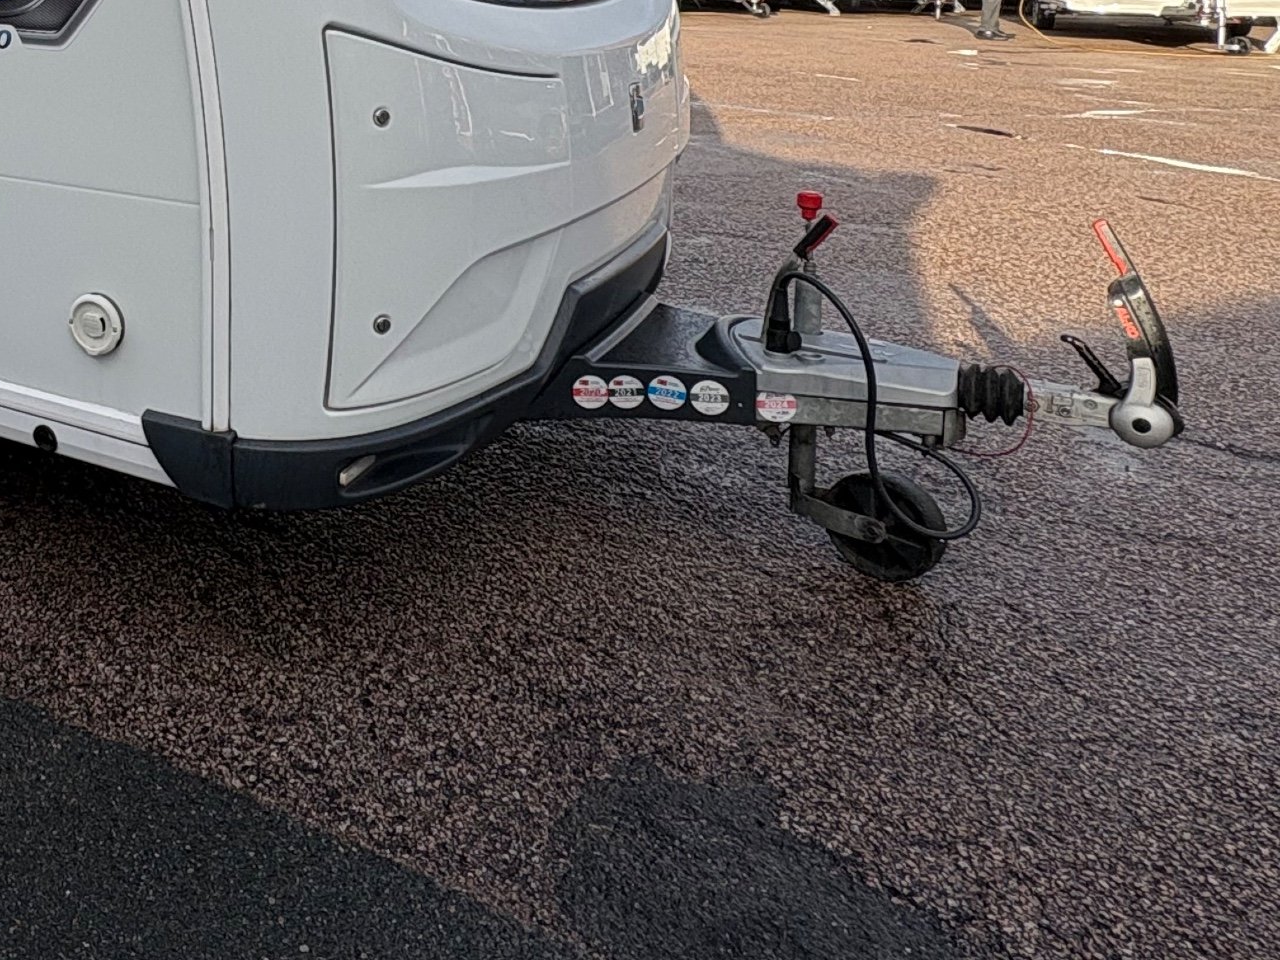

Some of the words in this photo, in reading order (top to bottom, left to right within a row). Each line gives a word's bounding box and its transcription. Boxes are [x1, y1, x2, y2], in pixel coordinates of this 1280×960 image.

[614, 388, 637, 397] 2021
[656, 387, 681, 398] 2022
[698, 393, 722, 402] 2023
[765, 401, 789, 409] 2024
